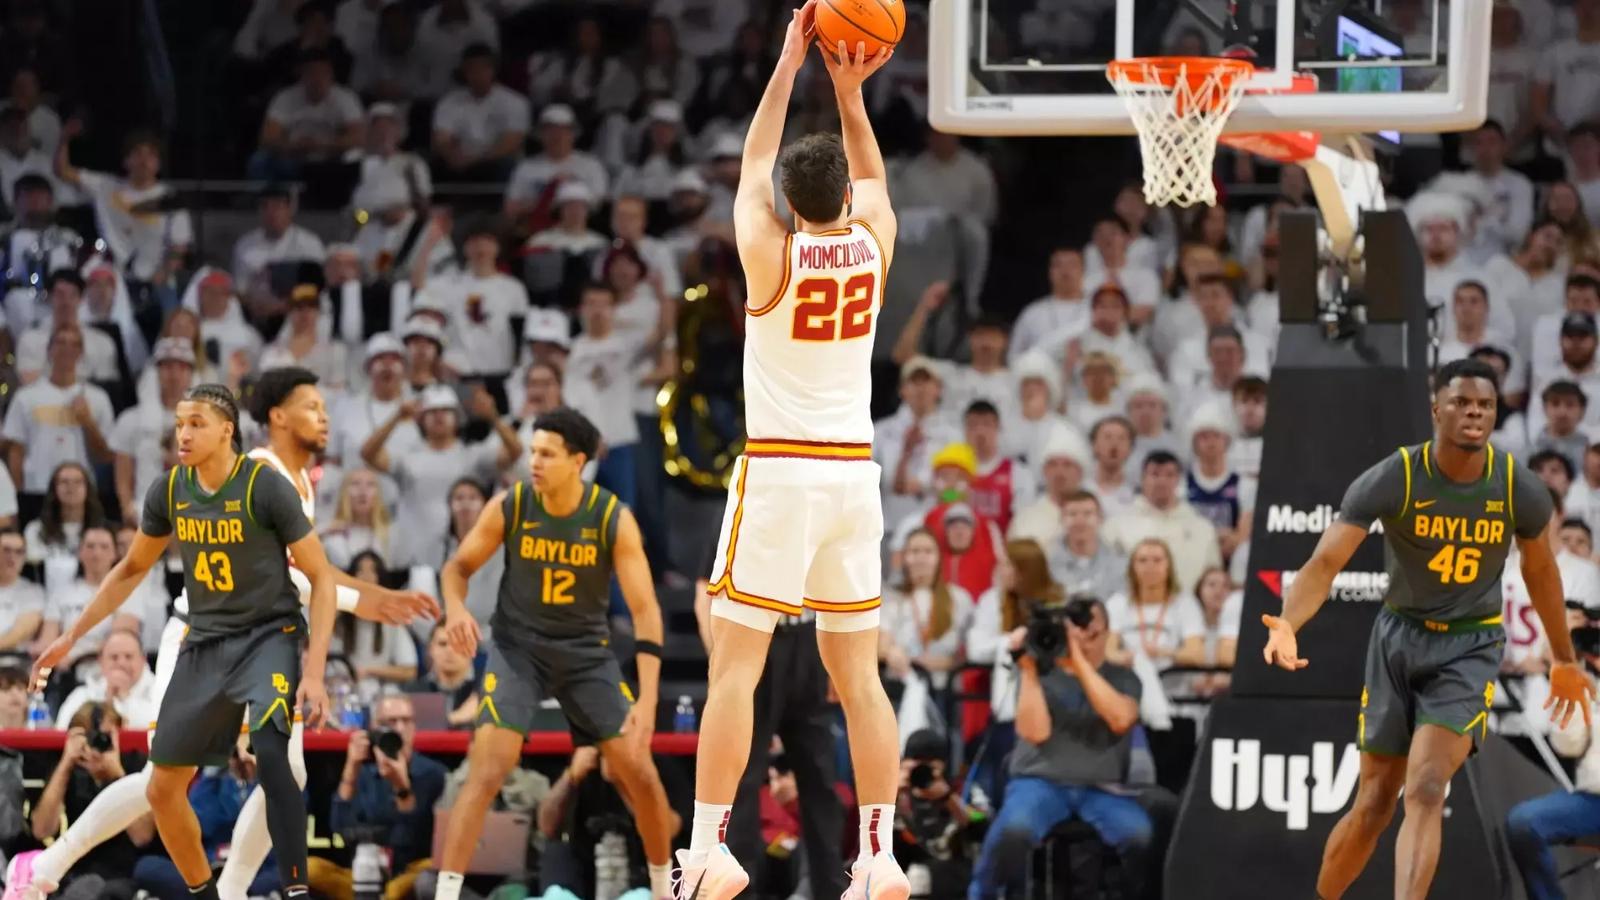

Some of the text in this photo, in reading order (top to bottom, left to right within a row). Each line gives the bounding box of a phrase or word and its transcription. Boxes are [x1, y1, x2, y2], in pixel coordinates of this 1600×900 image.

[799, 239, 875, 269] MOMCILOVIC
[791, 271, 875, 341] 22
[176, 516, 244, 544] BAYLOR
[1415, 514, 1504, 544] BAYLOR
[520, 535, 598, 567] BAYLOR
[1427, 544, 1482, 584] 46
[194, 551, 234, 592] 43
[542, 567, 576, 604] 12
[1211, 737, 1360, 830] HyV
